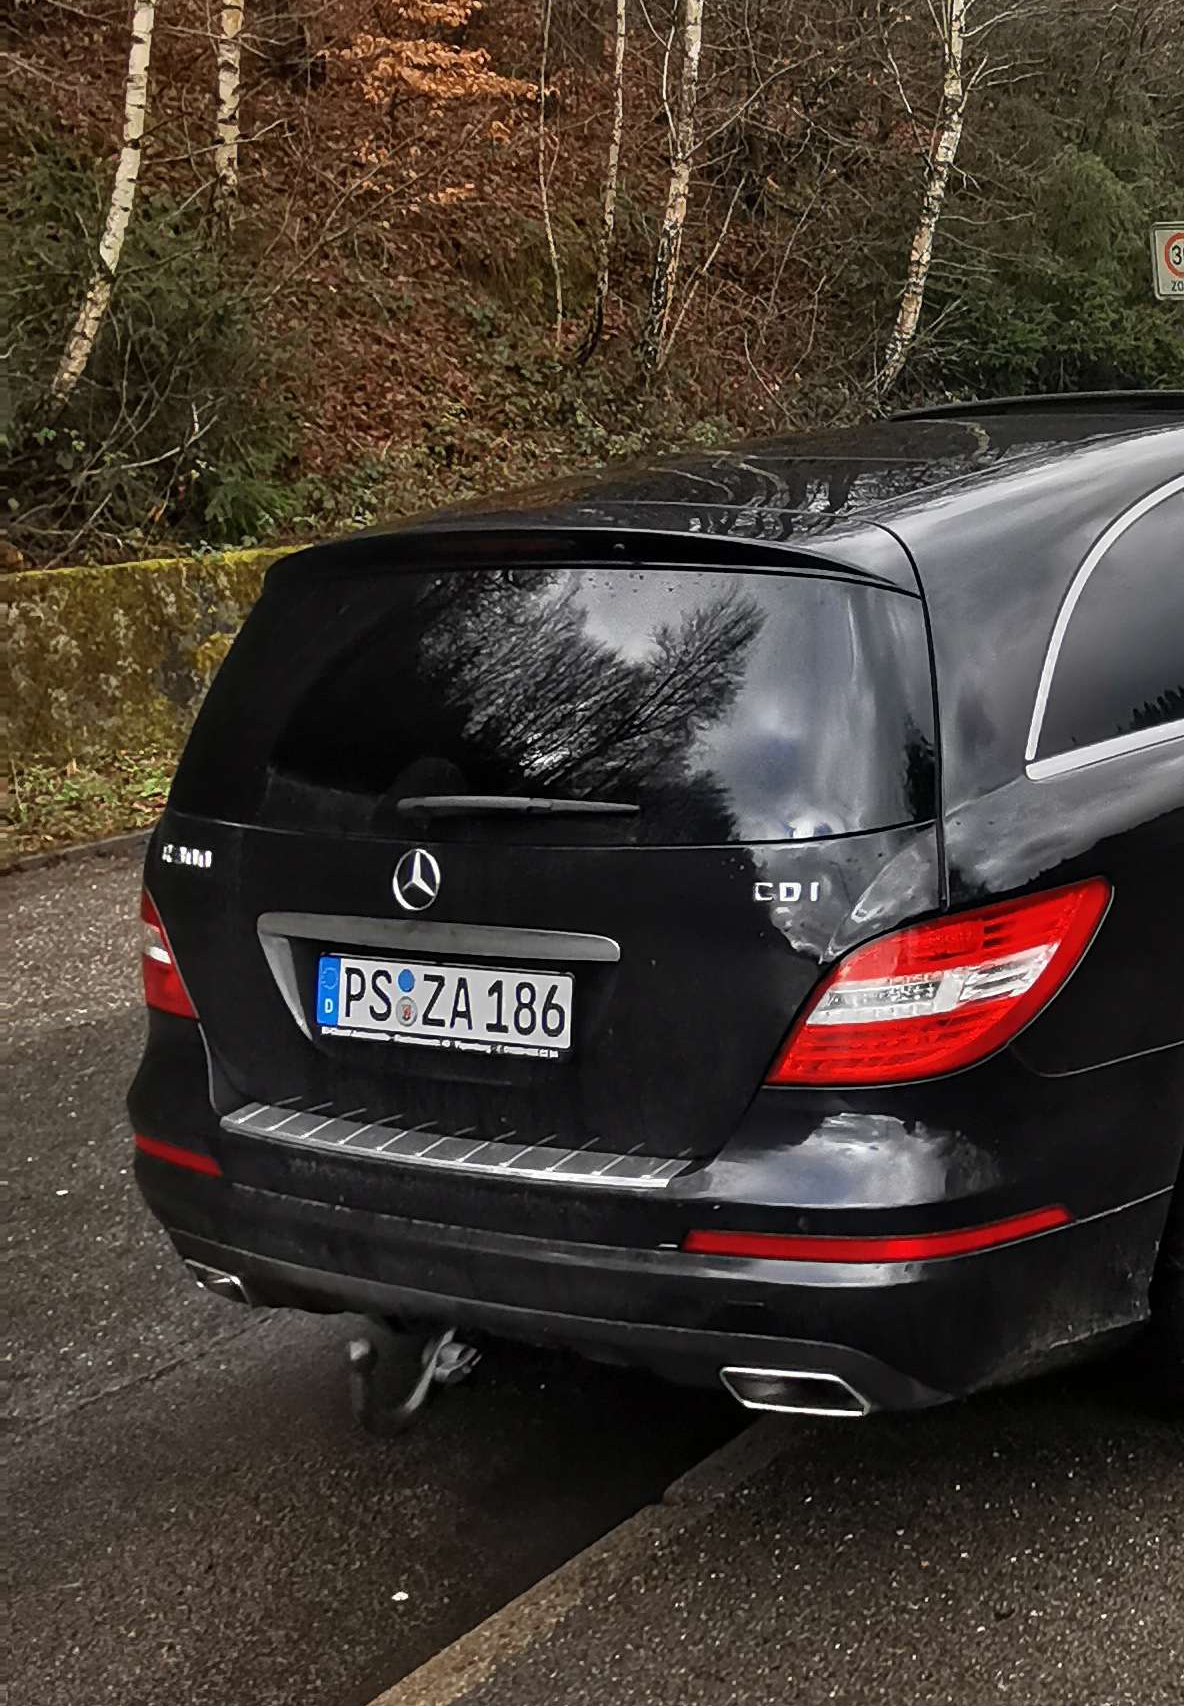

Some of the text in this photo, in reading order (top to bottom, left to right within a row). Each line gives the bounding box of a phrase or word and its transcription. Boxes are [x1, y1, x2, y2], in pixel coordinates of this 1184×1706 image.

[754, 881, 820, 902] CDI
[324, 997, 334, 1014] D
[344, 966, 566, 1038] PS ZA 186
